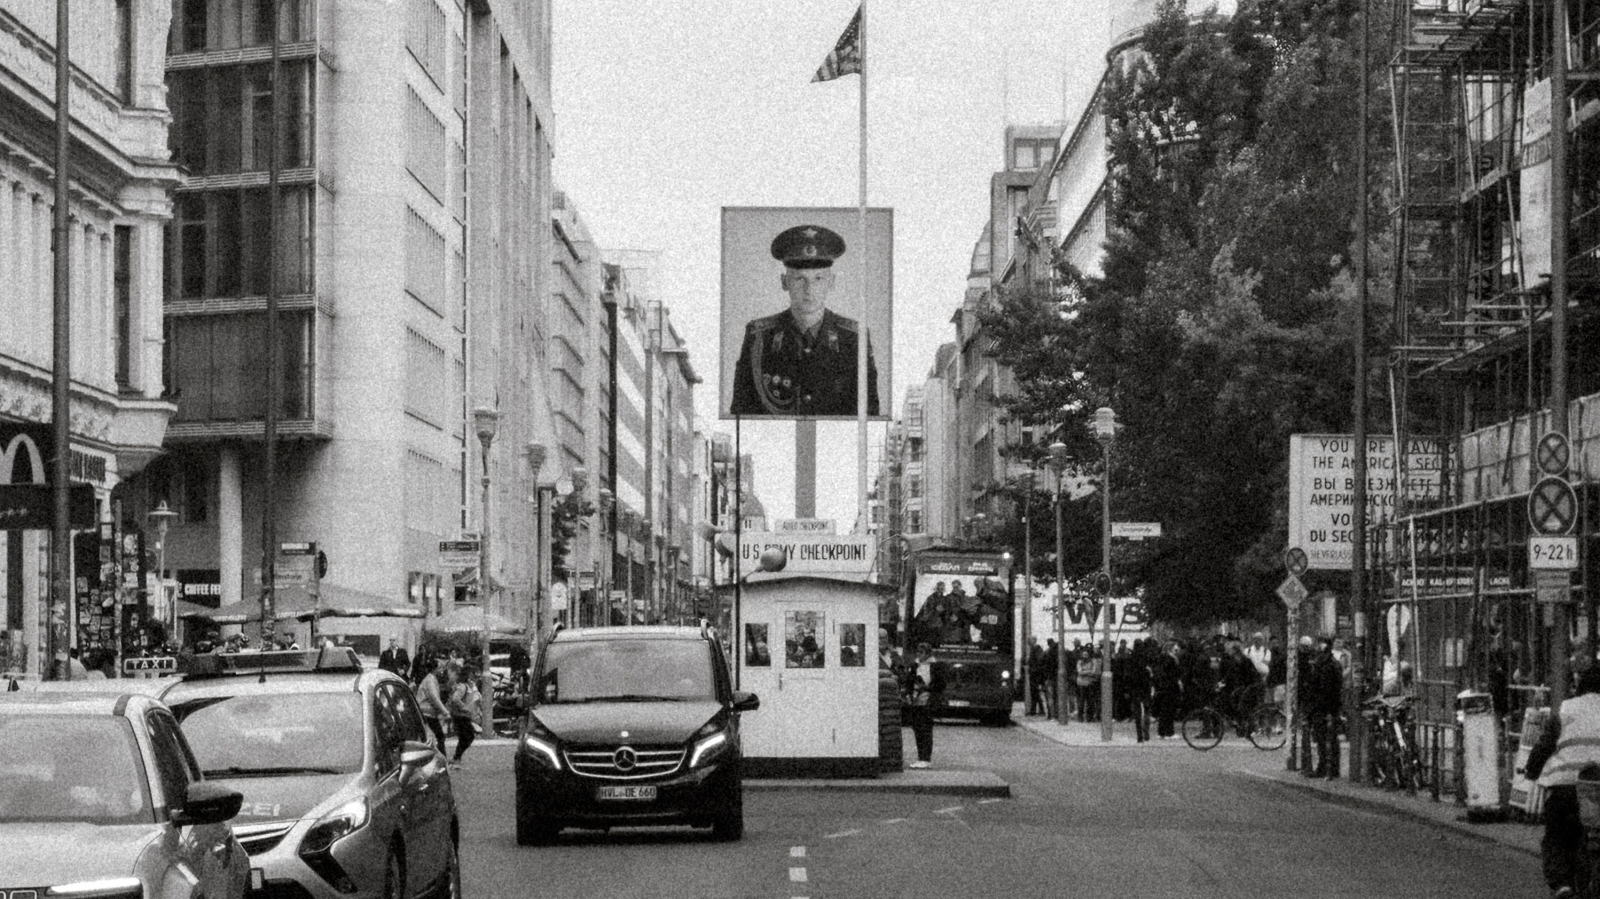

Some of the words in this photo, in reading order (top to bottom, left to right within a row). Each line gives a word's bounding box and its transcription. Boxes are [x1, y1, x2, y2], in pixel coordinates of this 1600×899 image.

[1319, 440, 1349, 453] YOU
[1312, 457, 1333, 469] THE
[1314, 478, 1335, 490] ВЫ
[1330, 514, 1370, 526] VOS
[1310, 531, 1326, 543] DU
[800, 544, 867, 560] CHECKPOINT
[184, 583, 209, 595] COFFEE
[131, 659, 168, 670] TAXI
